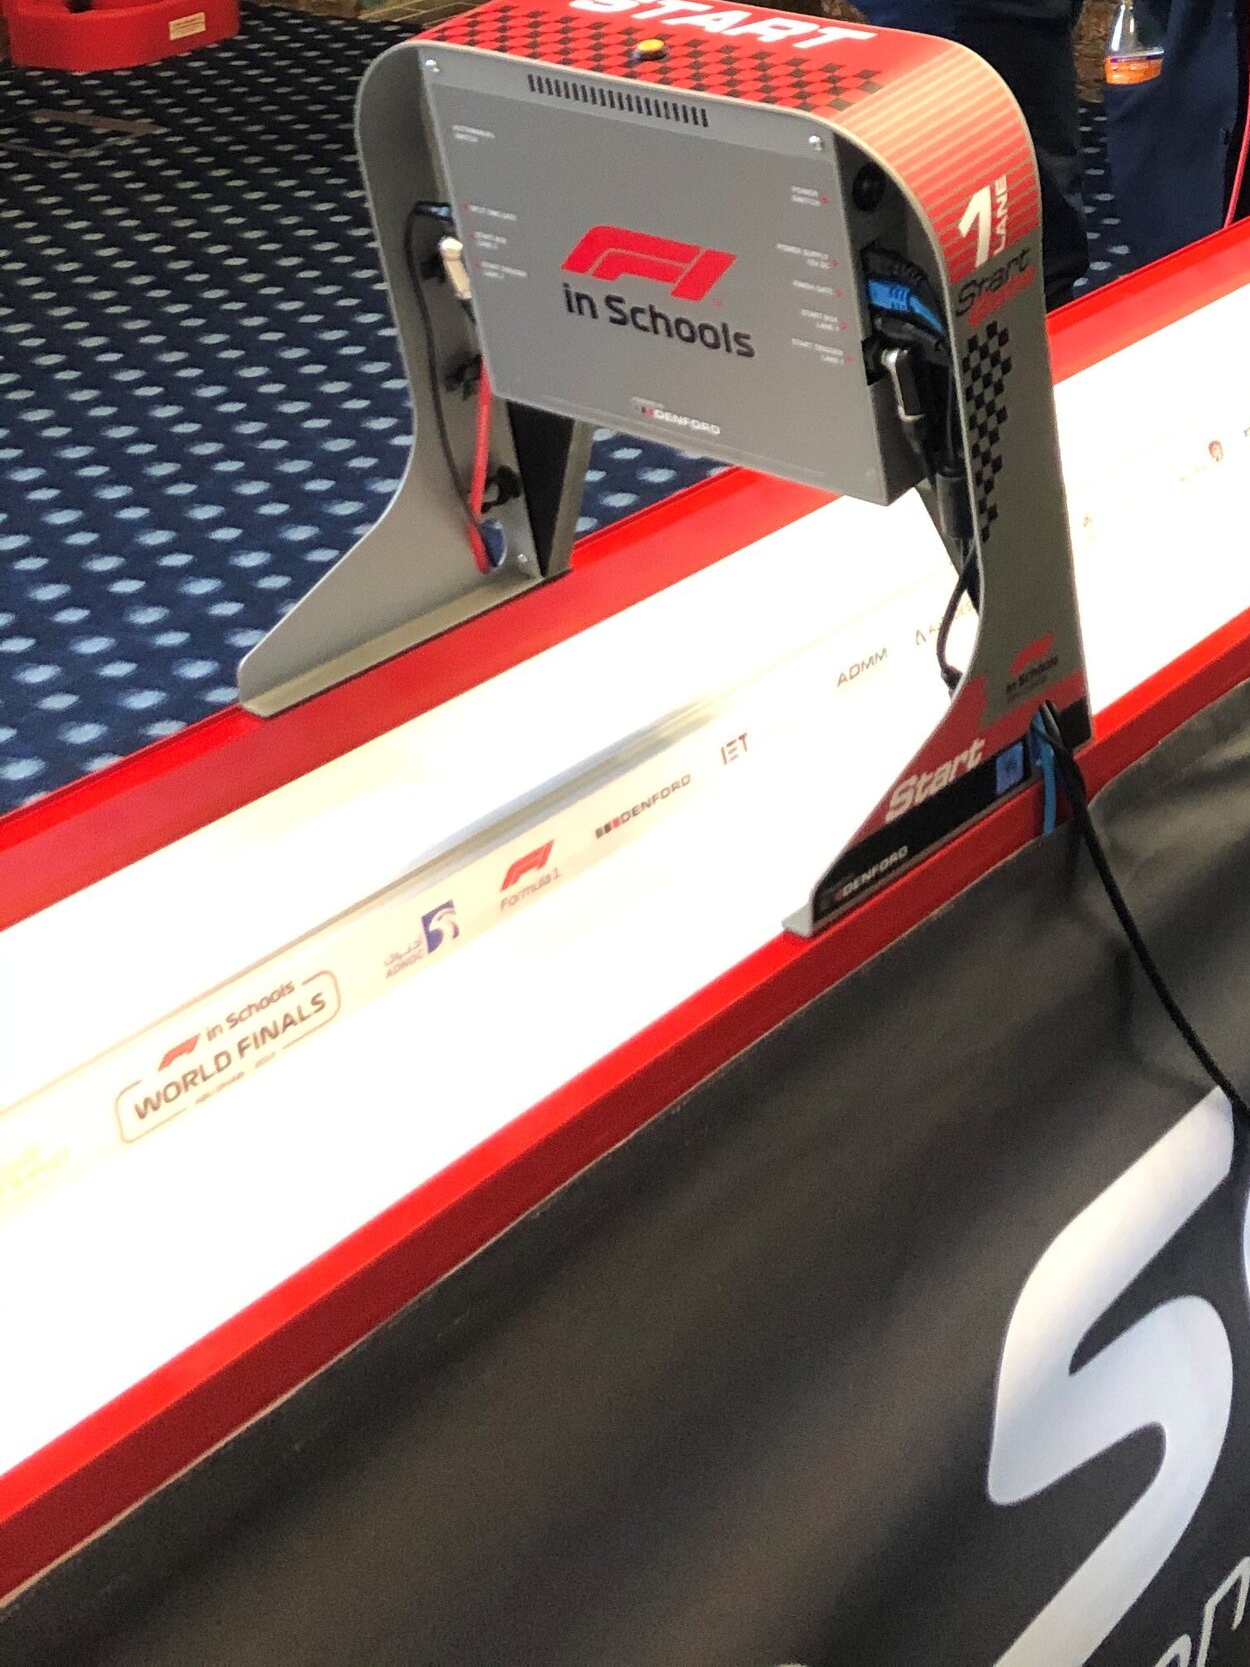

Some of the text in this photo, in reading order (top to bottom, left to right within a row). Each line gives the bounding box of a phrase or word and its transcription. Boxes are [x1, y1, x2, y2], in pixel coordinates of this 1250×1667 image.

[959, 174, 1009, 268] 1 LANE
[956, 247, 1031, 318] Start
[563, 282, 755, 358] in Schools
[654, 408, 721, 435] DENFORD
[837, 647, 888, 687] ADMM
[721, 732, 748, 765] IET
[620, 773, 692, 825] DENFORD
[885, 737, 986, 824] Start
[500, 866, 562, 911] Formula 1
[842, 845, 909, 897] DENFORD
[206, 1023, 224, 1042] in
[225, 980, 296, 1029] Schools
[134, 1049, 232, 1120] WORLD
[236, 991, 327, 1060] FINALS
